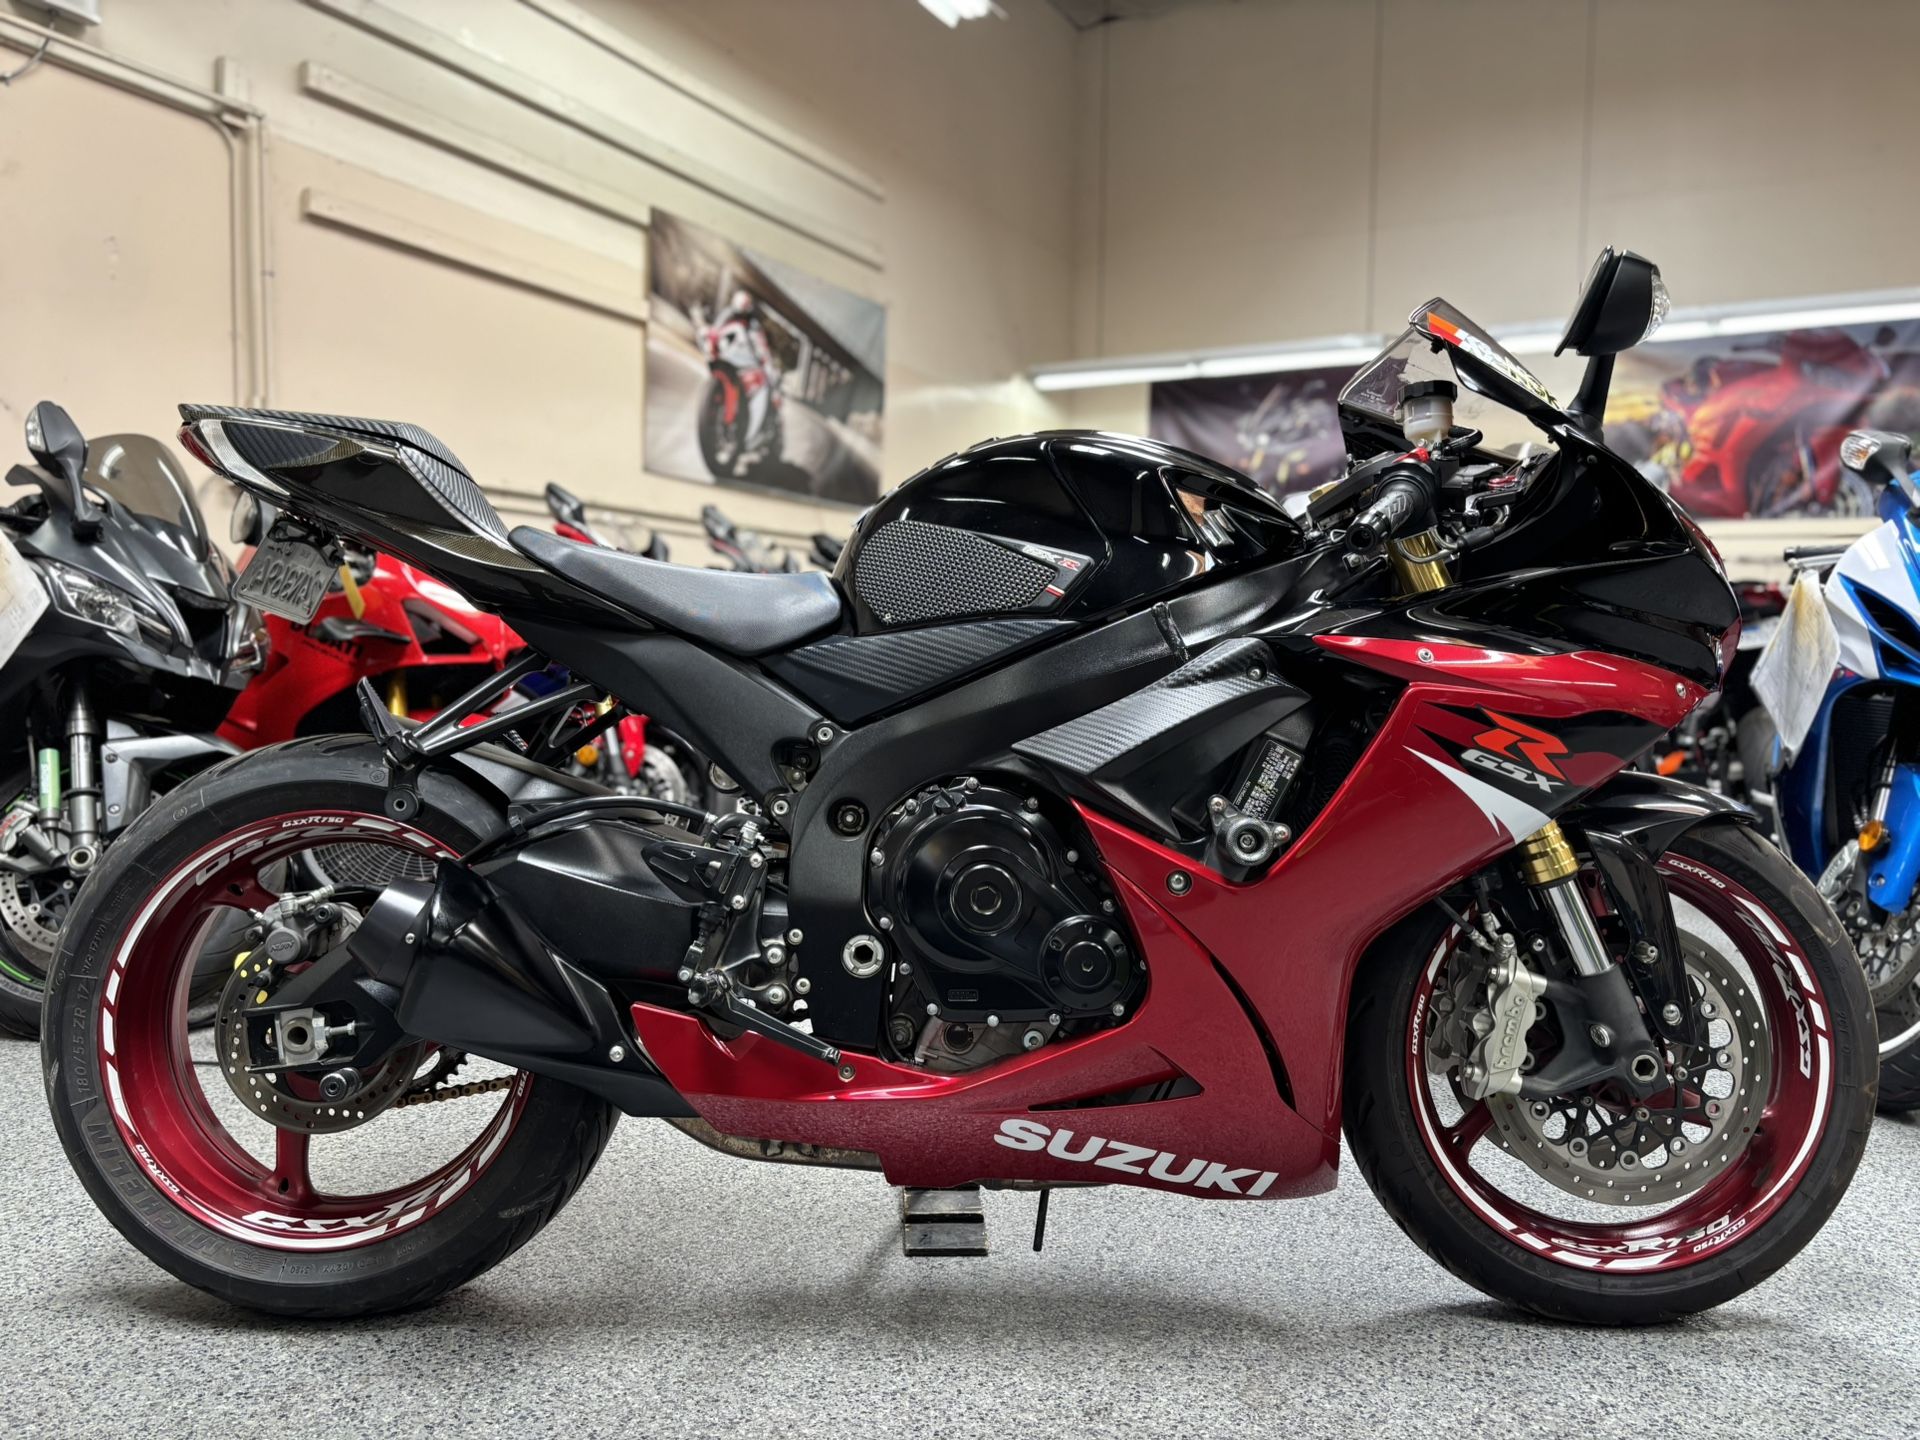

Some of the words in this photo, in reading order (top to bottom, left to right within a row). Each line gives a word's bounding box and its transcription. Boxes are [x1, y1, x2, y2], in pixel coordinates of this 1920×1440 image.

[1460, 748, 1565, 793] GSX
[1493, 994, 1524, 1071] brembo
[994, 1119, 1280, 1198] SUZUKI
